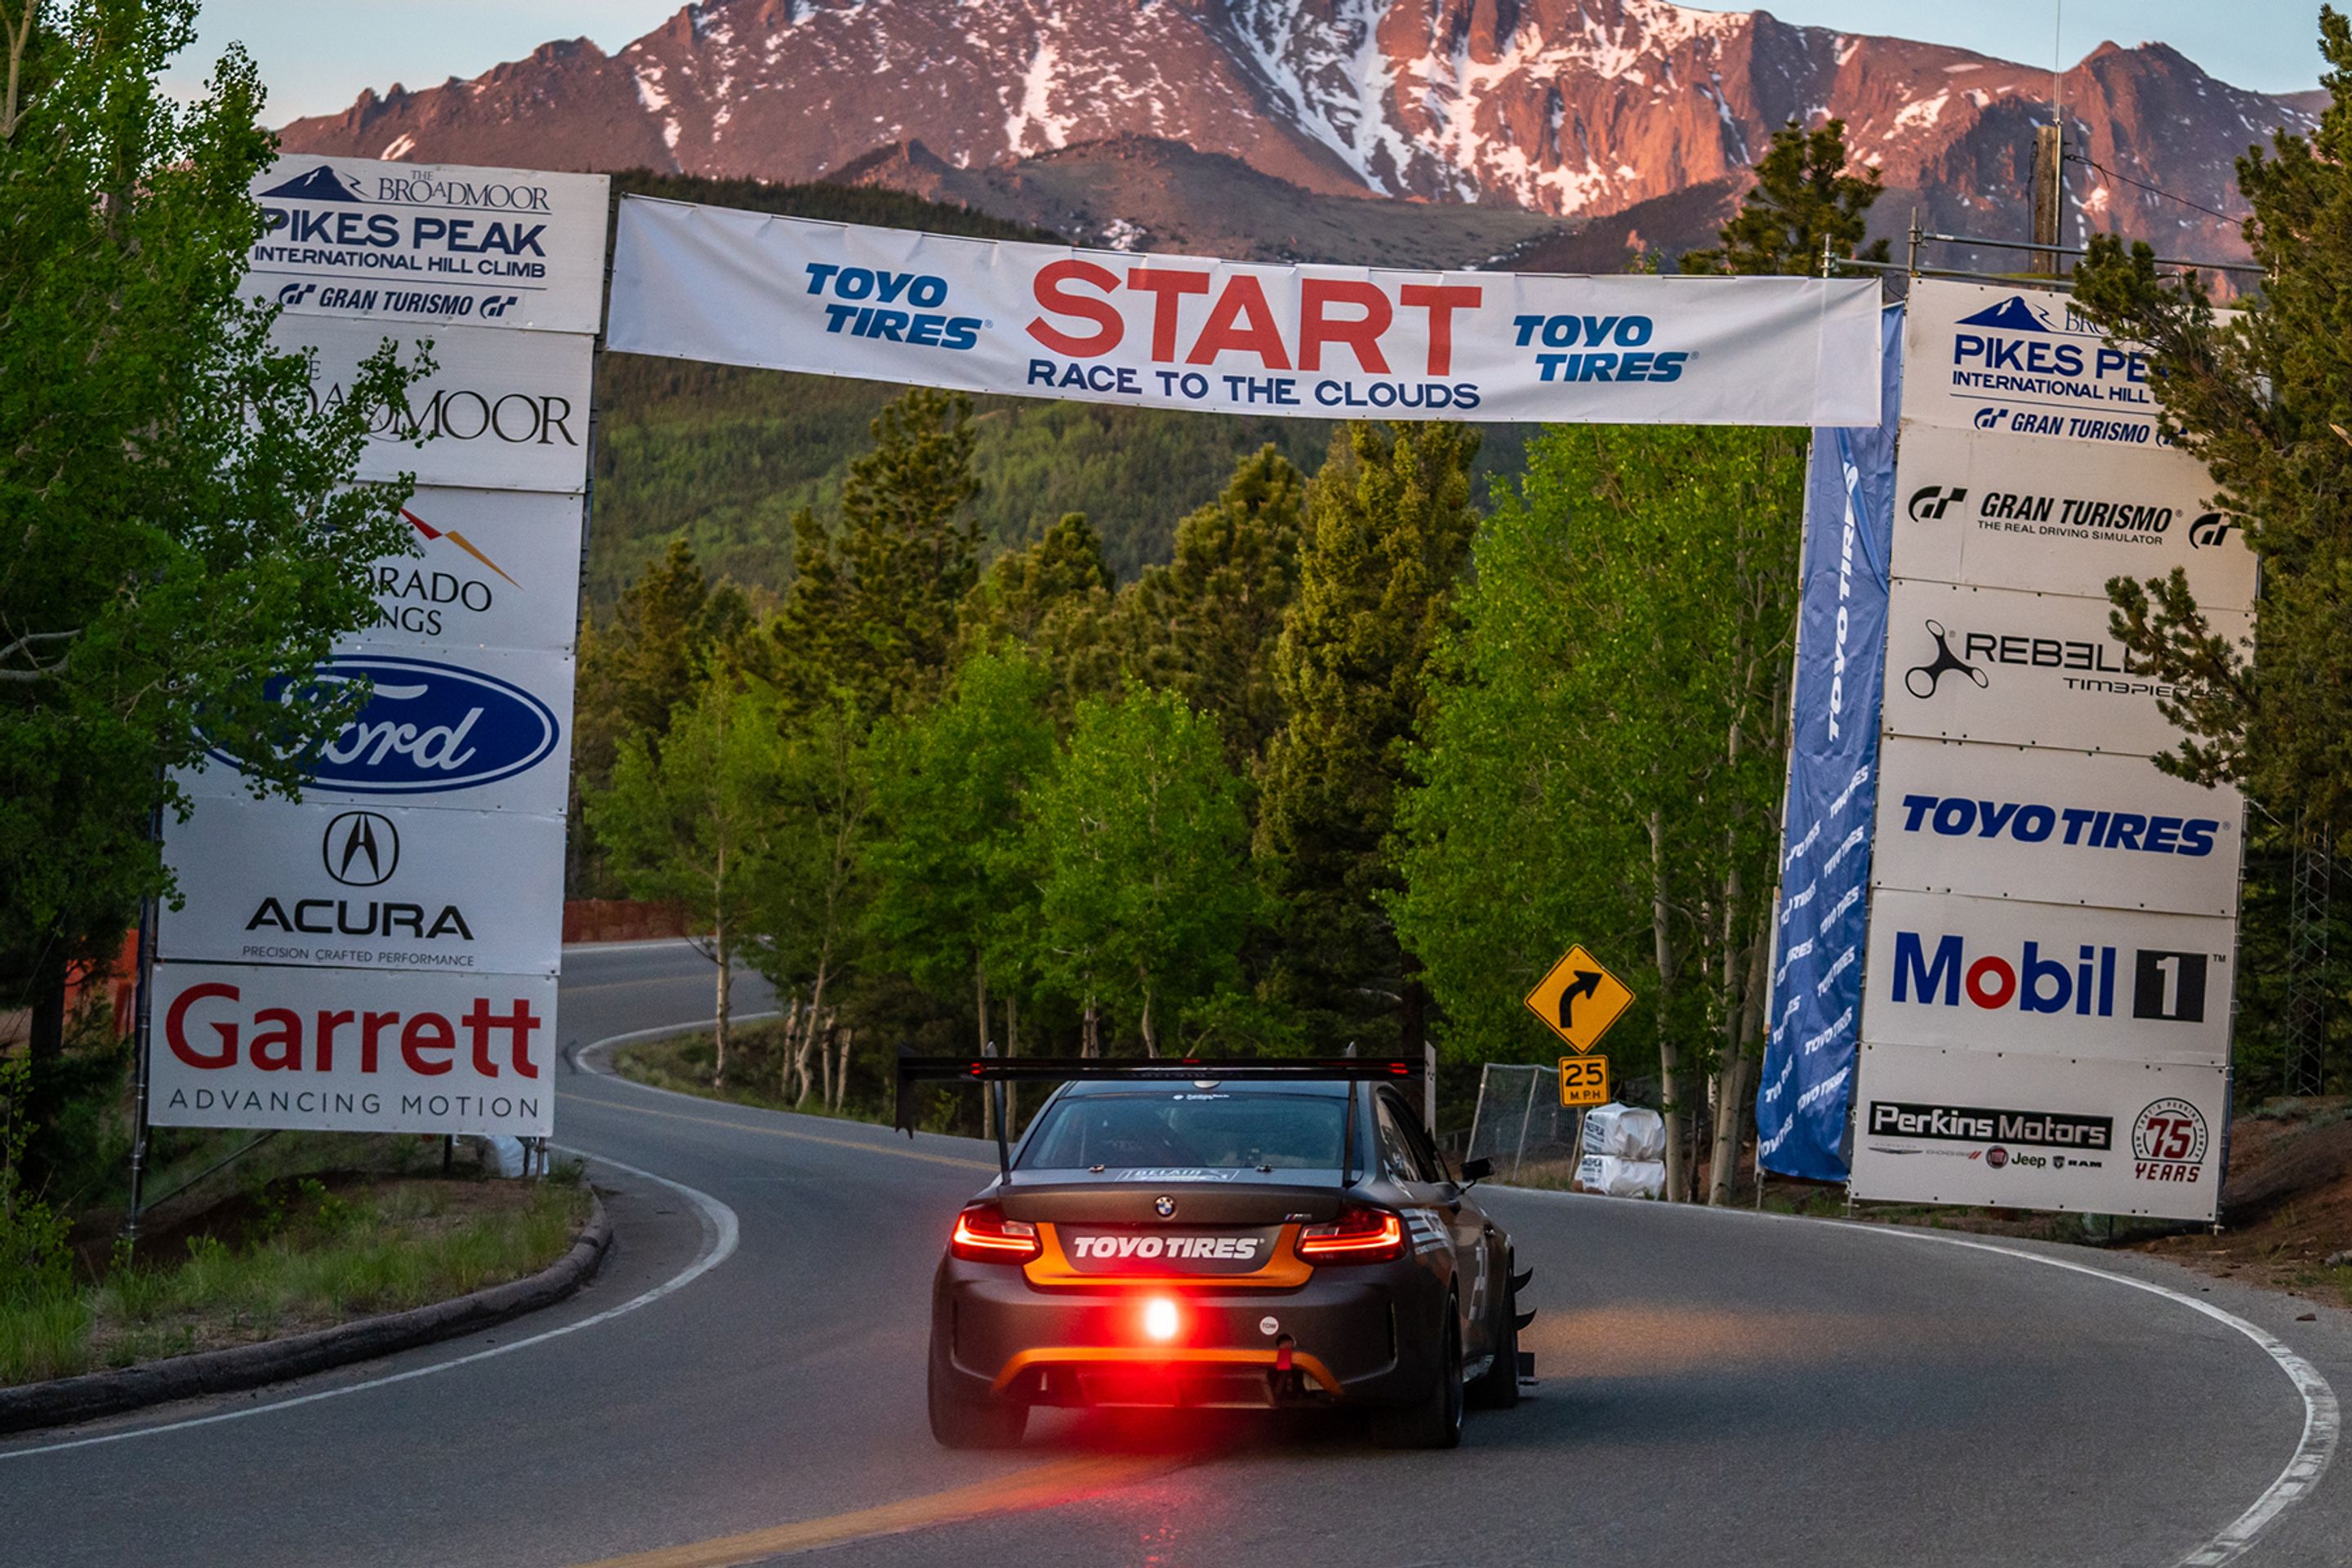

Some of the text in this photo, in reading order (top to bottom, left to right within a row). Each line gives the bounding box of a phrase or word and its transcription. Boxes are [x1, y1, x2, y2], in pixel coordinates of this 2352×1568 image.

[411, 170, 434, 181] THE
[378, 177, 550, 211] BROADMOOR
[261, 207, 547, 257] PIKES PEAK
[255, 246, 546, 278] INTERNATIONAL HILL CLIMB
[319, 287, 378, 310] GRAN
[383, 292, 474, 317] TURISMO
[805, 262, 949, 309] TOYO
[1025, 260, 1482, 377] START
[1512, 314, 1654, 348] TOYO
[1953, 333, 2084, 377] PIKES
[1027, 359, 1481, 409] RACE TO THE CLOUDS
[1953, 371, 2105, 400] INTERNATIONAL
[2109, 386, 2150, 404] HILL
[2011, 413, 2065, 435] GRAN
[2069, 418, 2150, 443] TURISMO
[1980, 492, 2056, 521] GRAN
[2062, 499, 2173, 533] TURISMO
[1978, 520, 2163, 546] THE REAL DRIVING SIMULATOR
[1828, 604, 1850, 742] TOYO
[1902, 795, 2056, 843] TOYO
[246, 898, 474, 941] ACURA
[243, 946, 474, 968] PRECISION CRAFTED PERFORMANCE
[1891, 931, 2117, 1018] Mobil
[2155, 956, 2180, 1017] 1
[166, 982, 541, 1080] Garrett
[1805, 1027, 1834, 1056] TOYO
[1565, 1063, 1604, 1087] 25
[169, 1089, 539, 1118] ADVANCING MOTION
[1874, 1105, 2106, 1145] Perkins Motors
[2146, 1117, 2194, 1159] 75
[2011, 1152, 2047, 1169] Jeep
[2068, 1159, 2103, 1169] RAM
[2135, 1162, 2201, 1183] YEARS
[1074, 1236, 1165, 1258] TOYO
